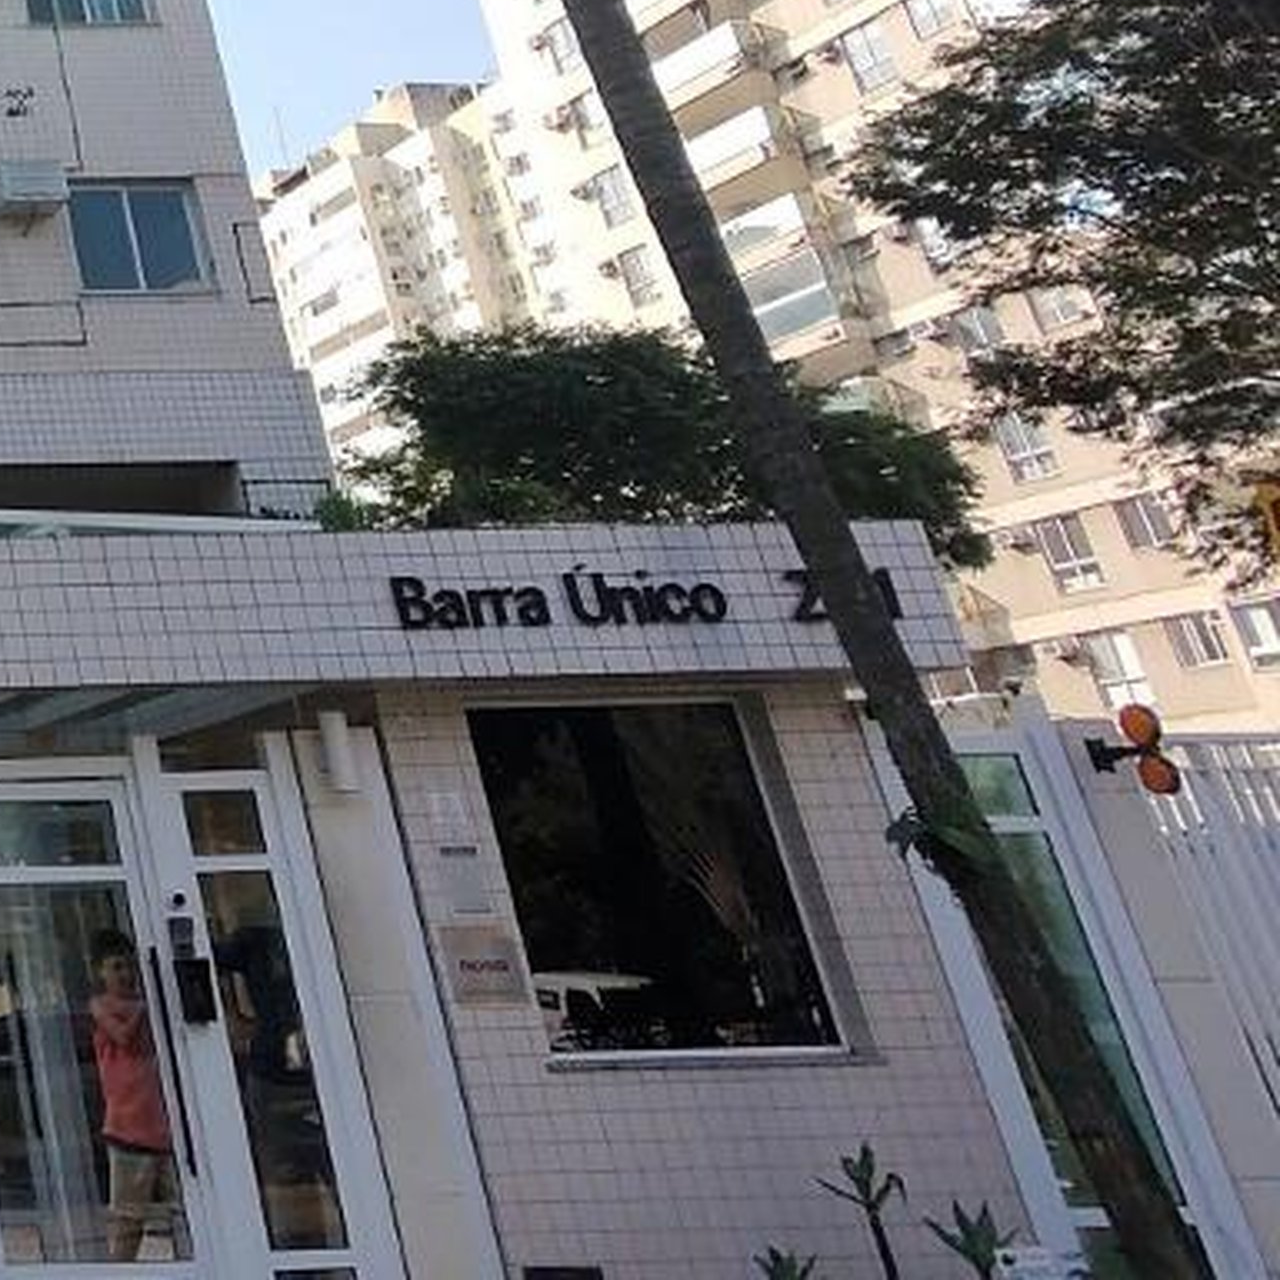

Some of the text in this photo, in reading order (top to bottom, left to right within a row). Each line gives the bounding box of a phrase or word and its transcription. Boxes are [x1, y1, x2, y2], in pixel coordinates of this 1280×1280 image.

[390, 563, 904, 629] Barra Único 21
